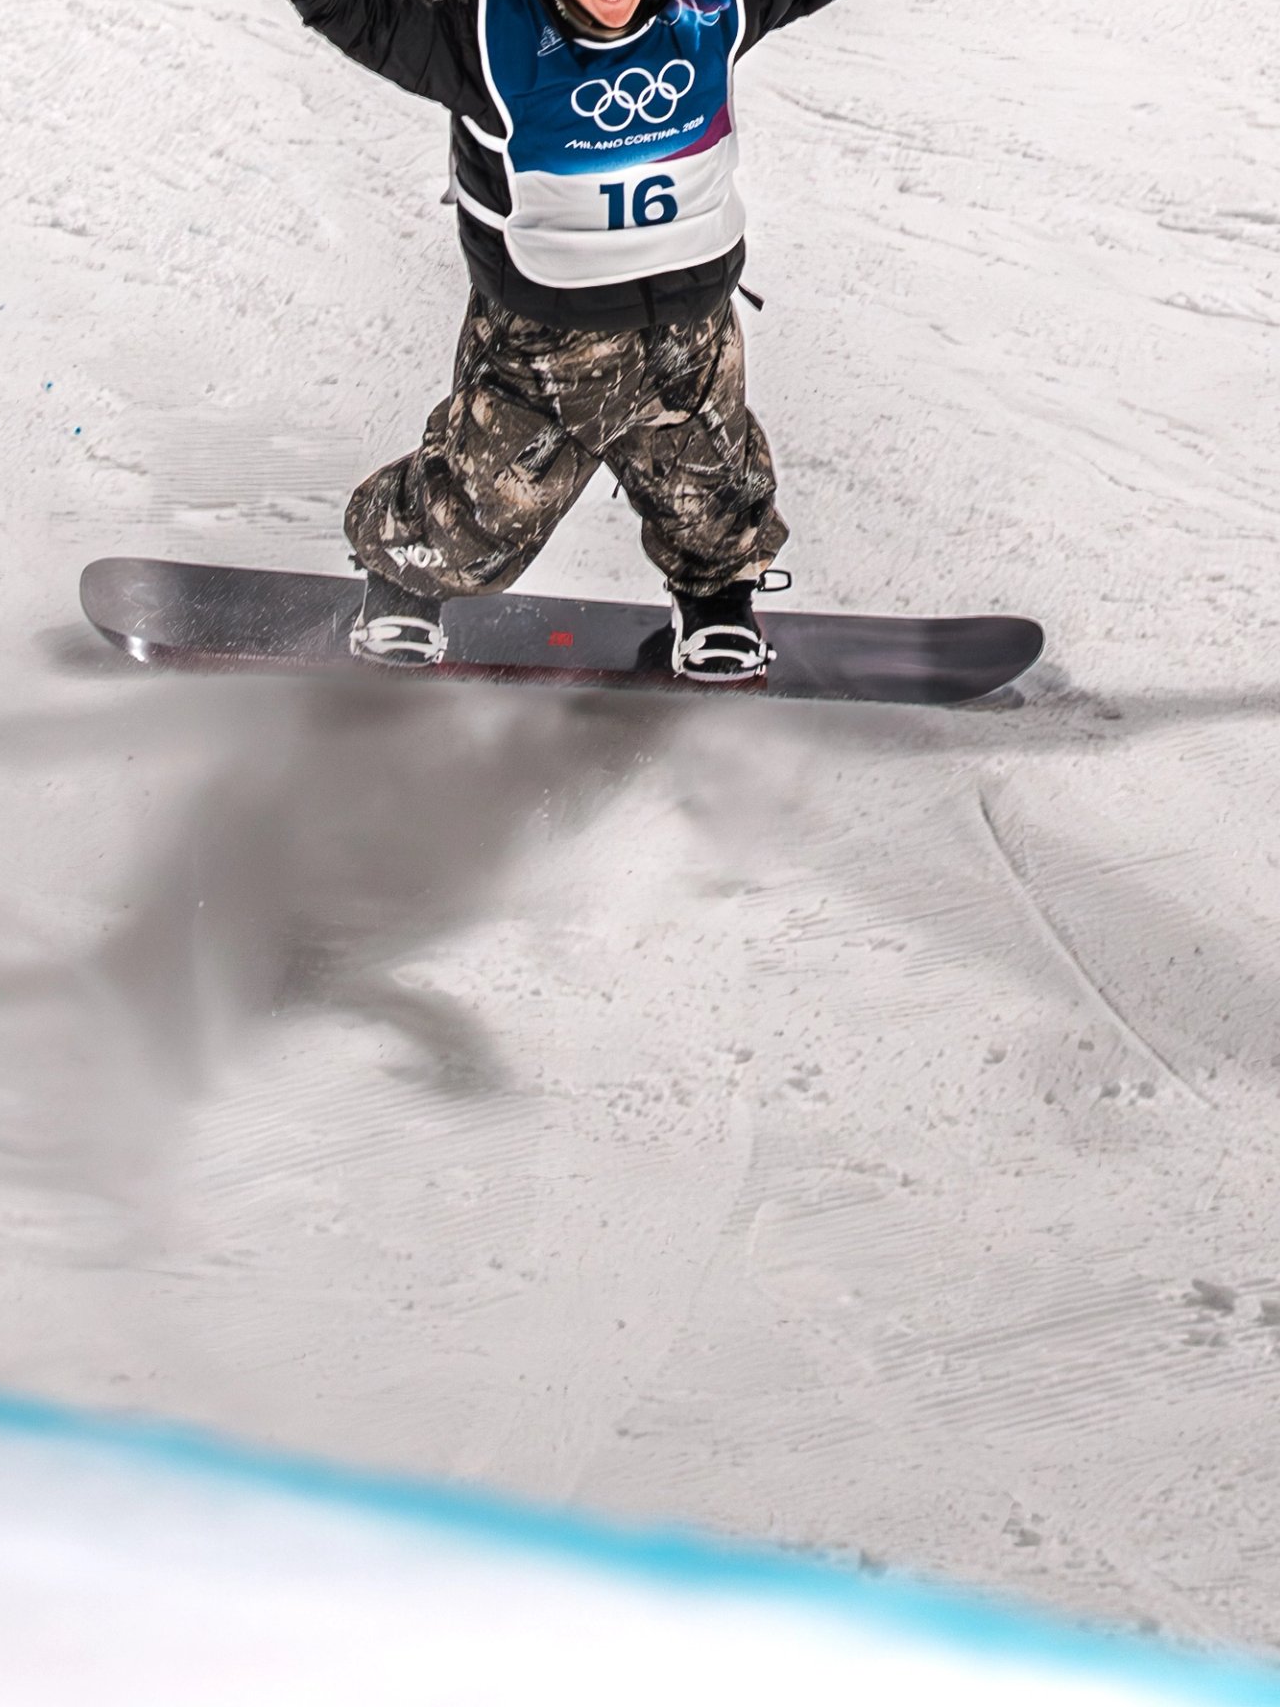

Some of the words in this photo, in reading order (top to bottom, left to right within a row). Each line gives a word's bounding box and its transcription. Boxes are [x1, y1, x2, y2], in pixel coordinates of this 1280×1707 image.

[564, 138, 623, 151] MILANO
[624, 127, 680, 145] CORTINA
[682, 114, 705, 133] 2026
[599, 174, 679, 231] 16
